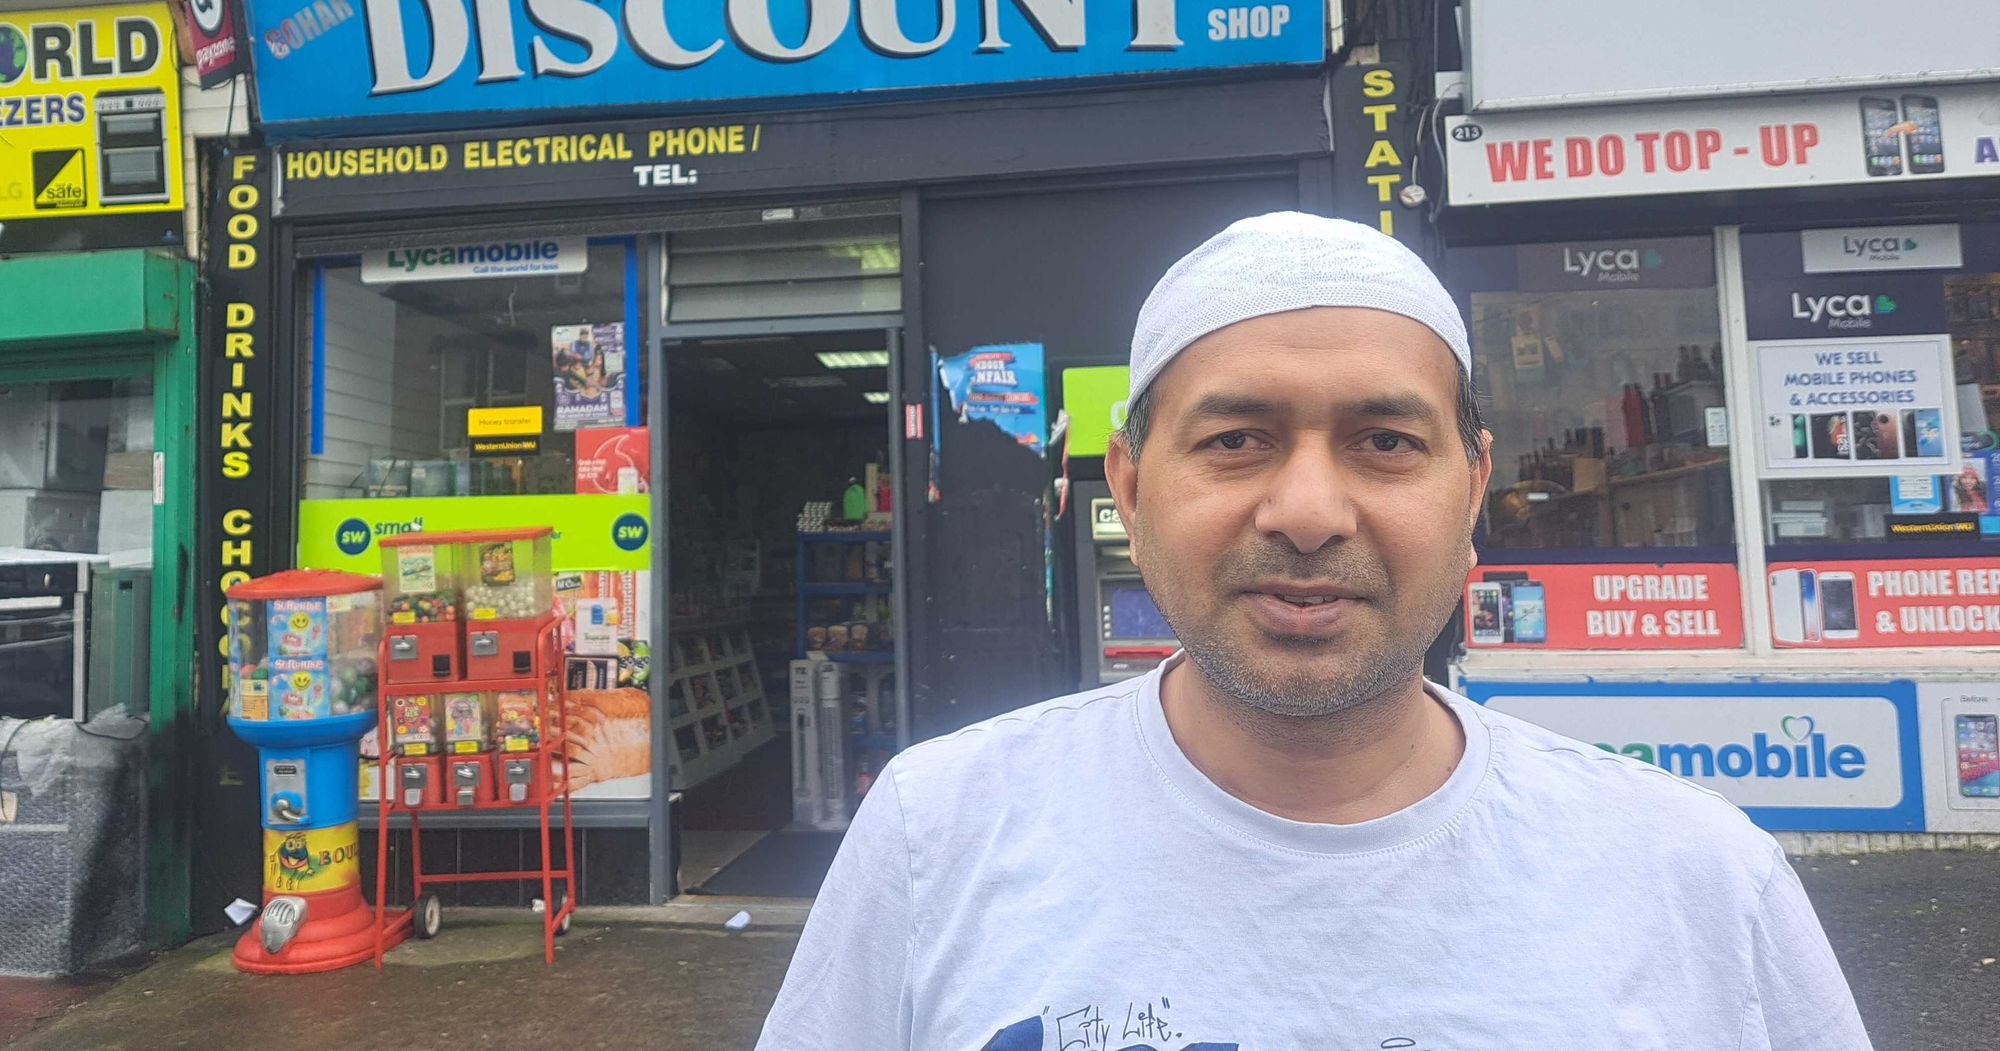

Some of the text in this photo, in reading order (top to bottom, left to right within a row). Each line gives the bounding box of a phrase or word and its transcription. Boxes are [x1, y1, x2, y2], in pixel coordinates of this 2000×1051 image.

[1207, 5, 1291, 41] SHOP
[0, 93, 86, 127] ZERS
[1454, 126, 1481, 139] 213
[286, 145, 449, 181] HOUSEHOLD
[463, 132, 633, 170] ELECTRICAL
[647, 125, 746, 158] PHONE
[1486, 137, 1555, 183] WE
[1566, 134, 1626, 178] DO
[1634, 129, 1723, 175] TOP
[1758, 123, 1819, 168] UP
[633, 164, 699, 187] TEL:
[47, 183, 82, 199] safe
[226, 155, 260, 269] FOOD
[387, 239, 560, 272] Lycamobile
[1843, 235, 1899, 256] Lyca
[505, 264, 529, 273] world
[1563, 247, 1640, 276] Lyca
[1791, 292, 1872, 323] Lyca
[1815, 351, 1883, 367] WE SELL
[220, 301, 255, 479] DRINKS
[1784, 370, 1917, 387] MOBILE PHONES
[556, 403, 609, 414] RAMADAN
[1789, 389, 1915, 406] & ACCESSORIES
[1592, 574, 1710, 602] UPGRADE
[1867, 569, 1953, 597] PHONE
[1586, 608, 1721, 637] BUY & SELL
[1875, 605, 2000, 634] & UNLOCK
